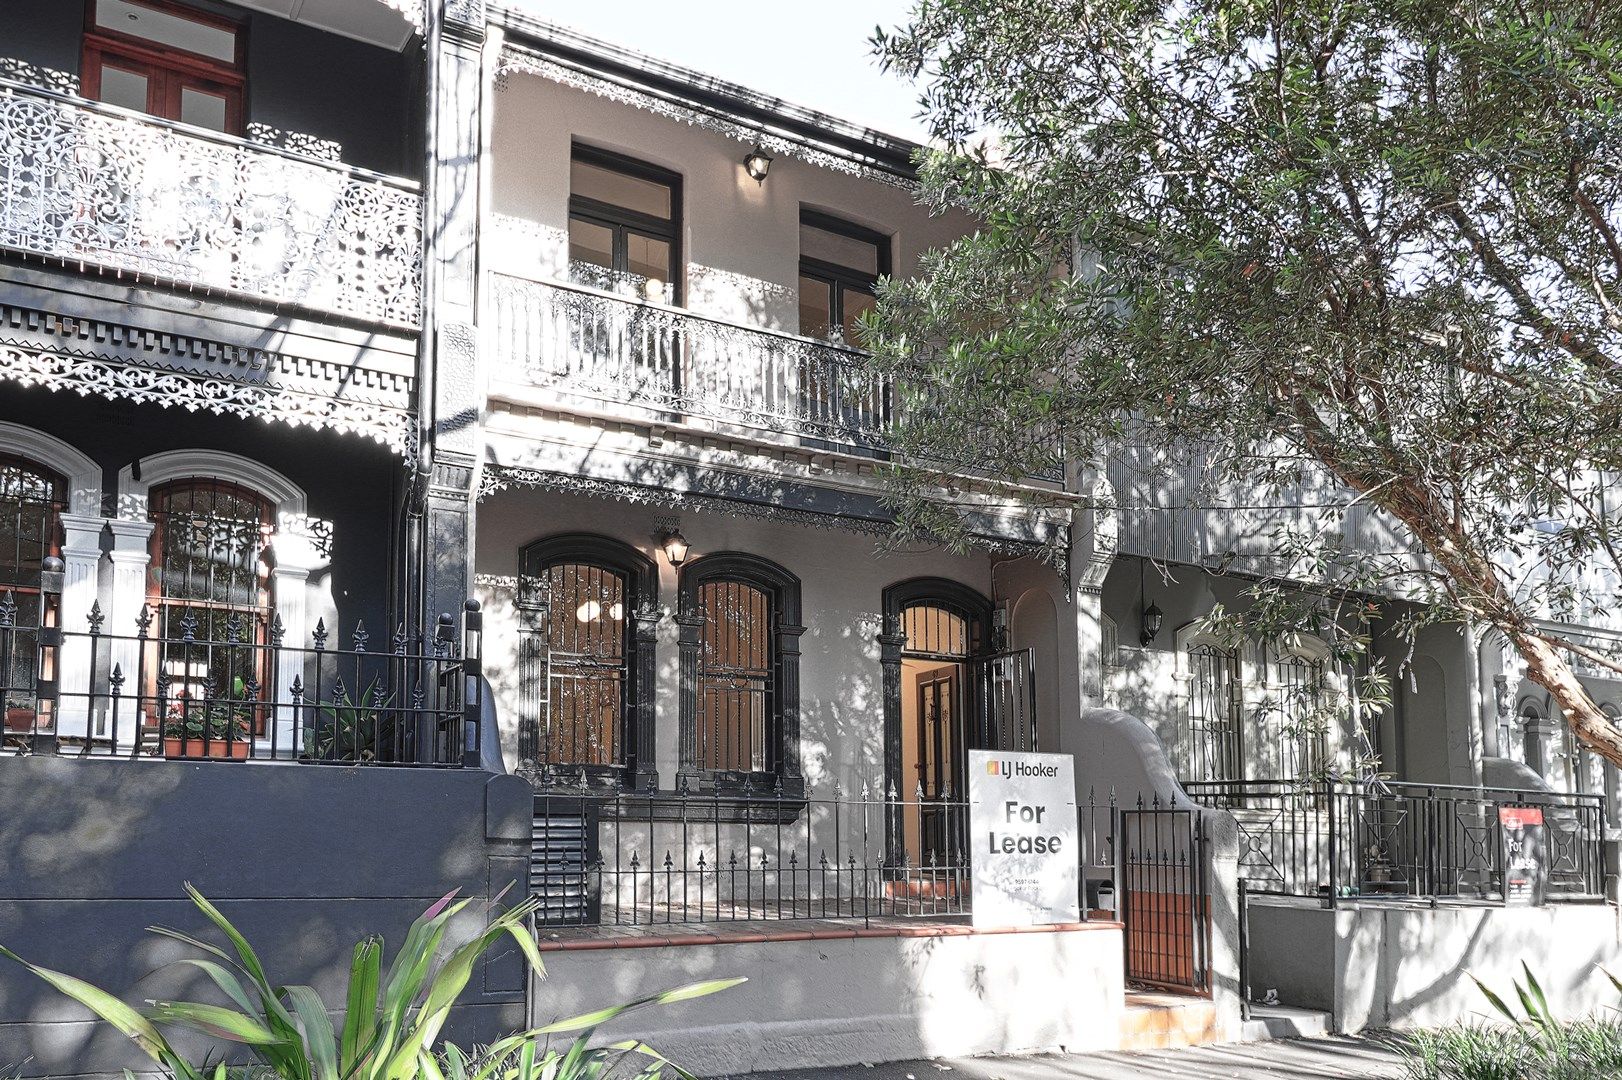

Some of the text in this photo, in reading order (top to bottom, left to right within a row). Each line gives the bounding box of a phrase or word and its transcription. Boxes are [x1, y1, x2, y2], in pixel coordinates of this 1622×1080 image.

[1001, 760, 1058, 779] LJ Hooker
[1005, 801, 1046, 824] For
[989, 831, 1062, 855] Lease
[1508, 838, 1522, 852] For
[1510, 856, 1536, 870] Lease
